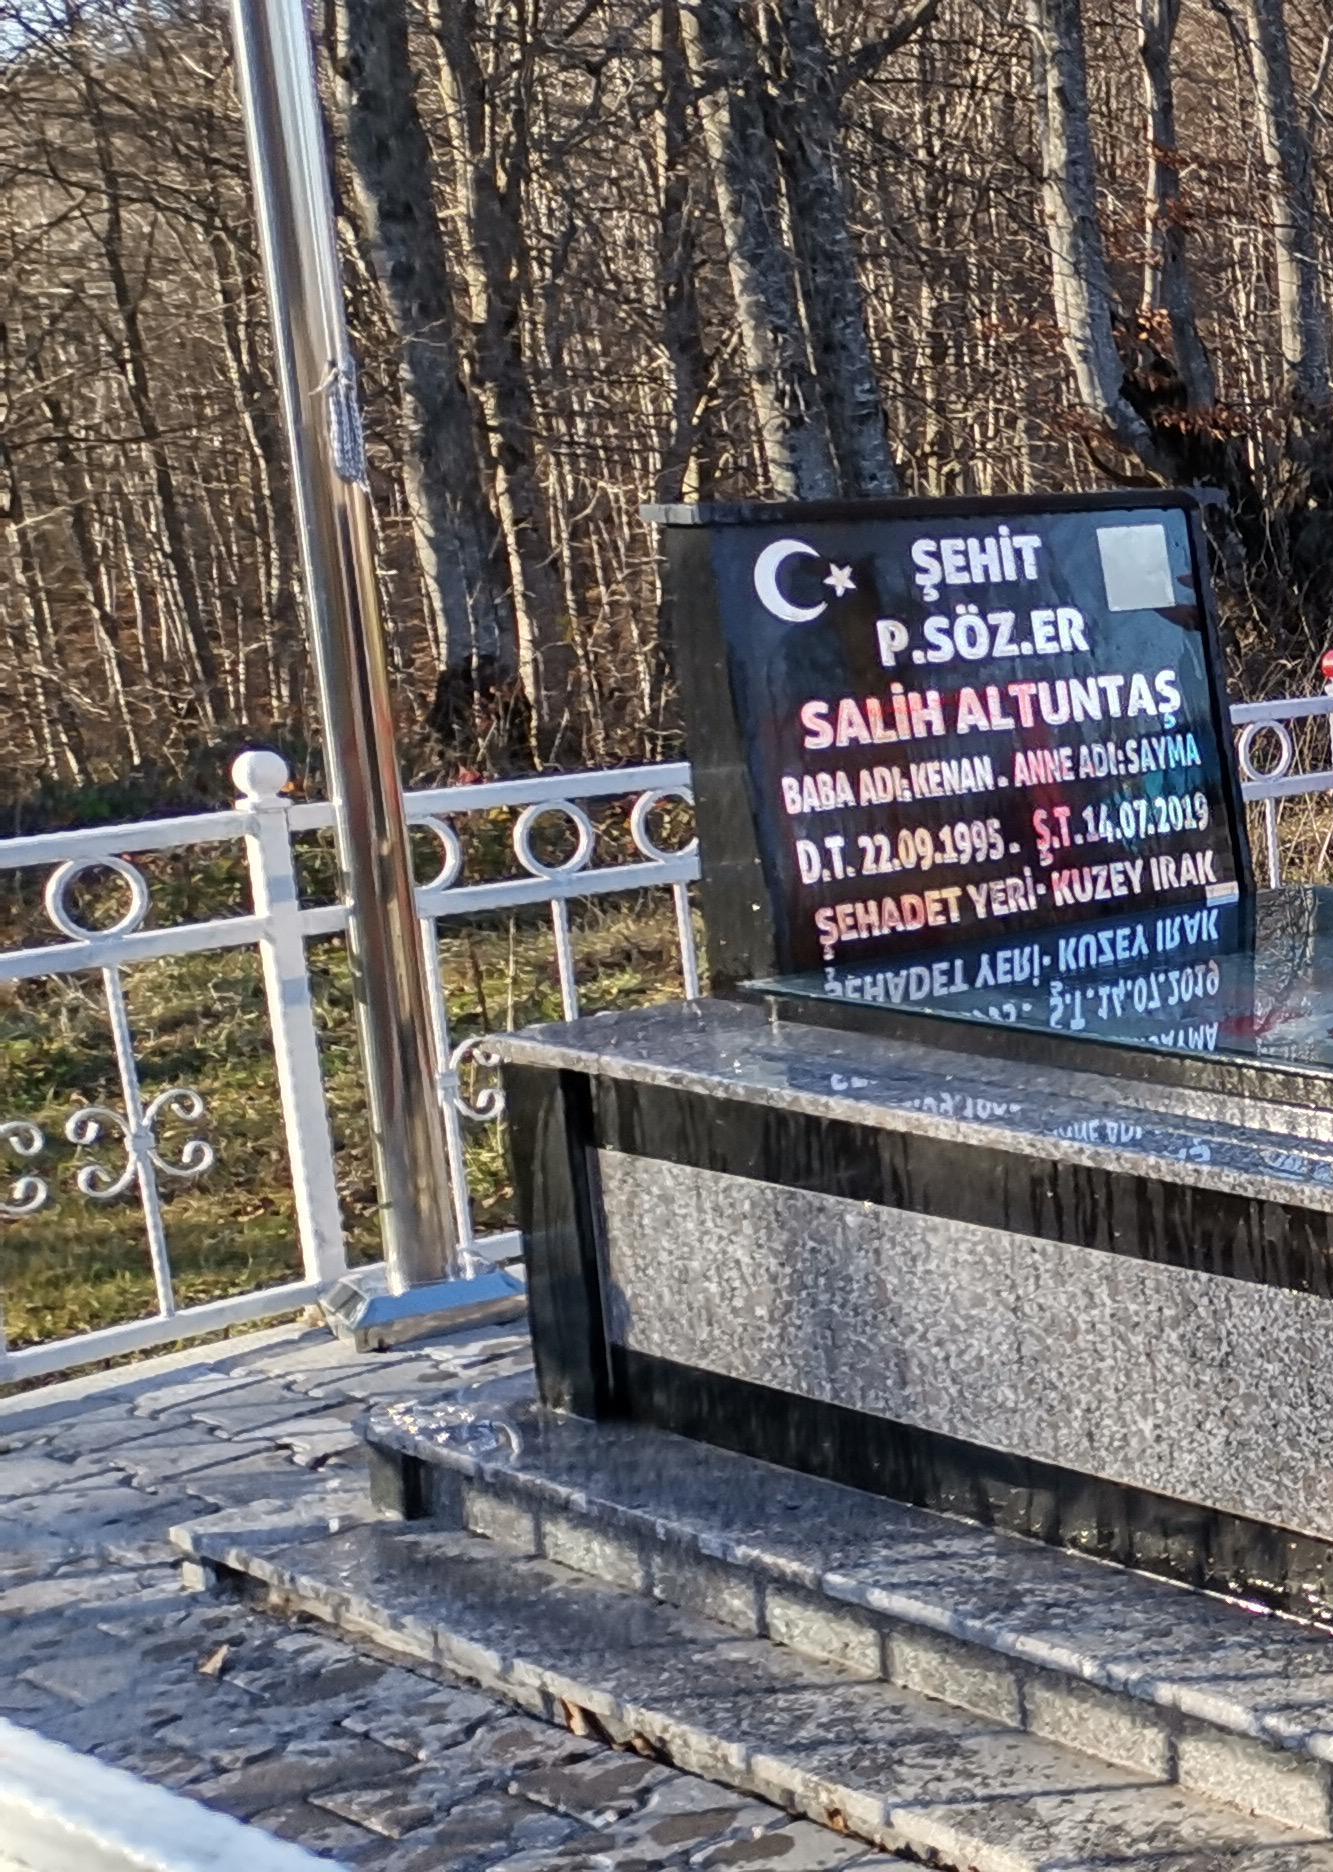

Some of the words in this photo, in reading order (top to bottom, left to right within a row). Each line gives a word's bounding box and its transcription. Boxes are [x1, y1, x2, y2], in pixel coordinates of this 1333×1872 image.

[911, 525, 1042, 602] ŞEHİT
[876, 604, 1090, 667] P.SÖZ.ER
[800, 682, 946, 750] SALİH
[957, 669, 1181, 735] ALTUNTAŞ
[781, 770, 857, 815] BABA
[1014, 746, 1075, 788] ANNE
[815, 886, 962, 961] ŞEHADET
[1051, 858, 1144, 907] KUZEY
[1150, 849, 1218, 892] IRAK
